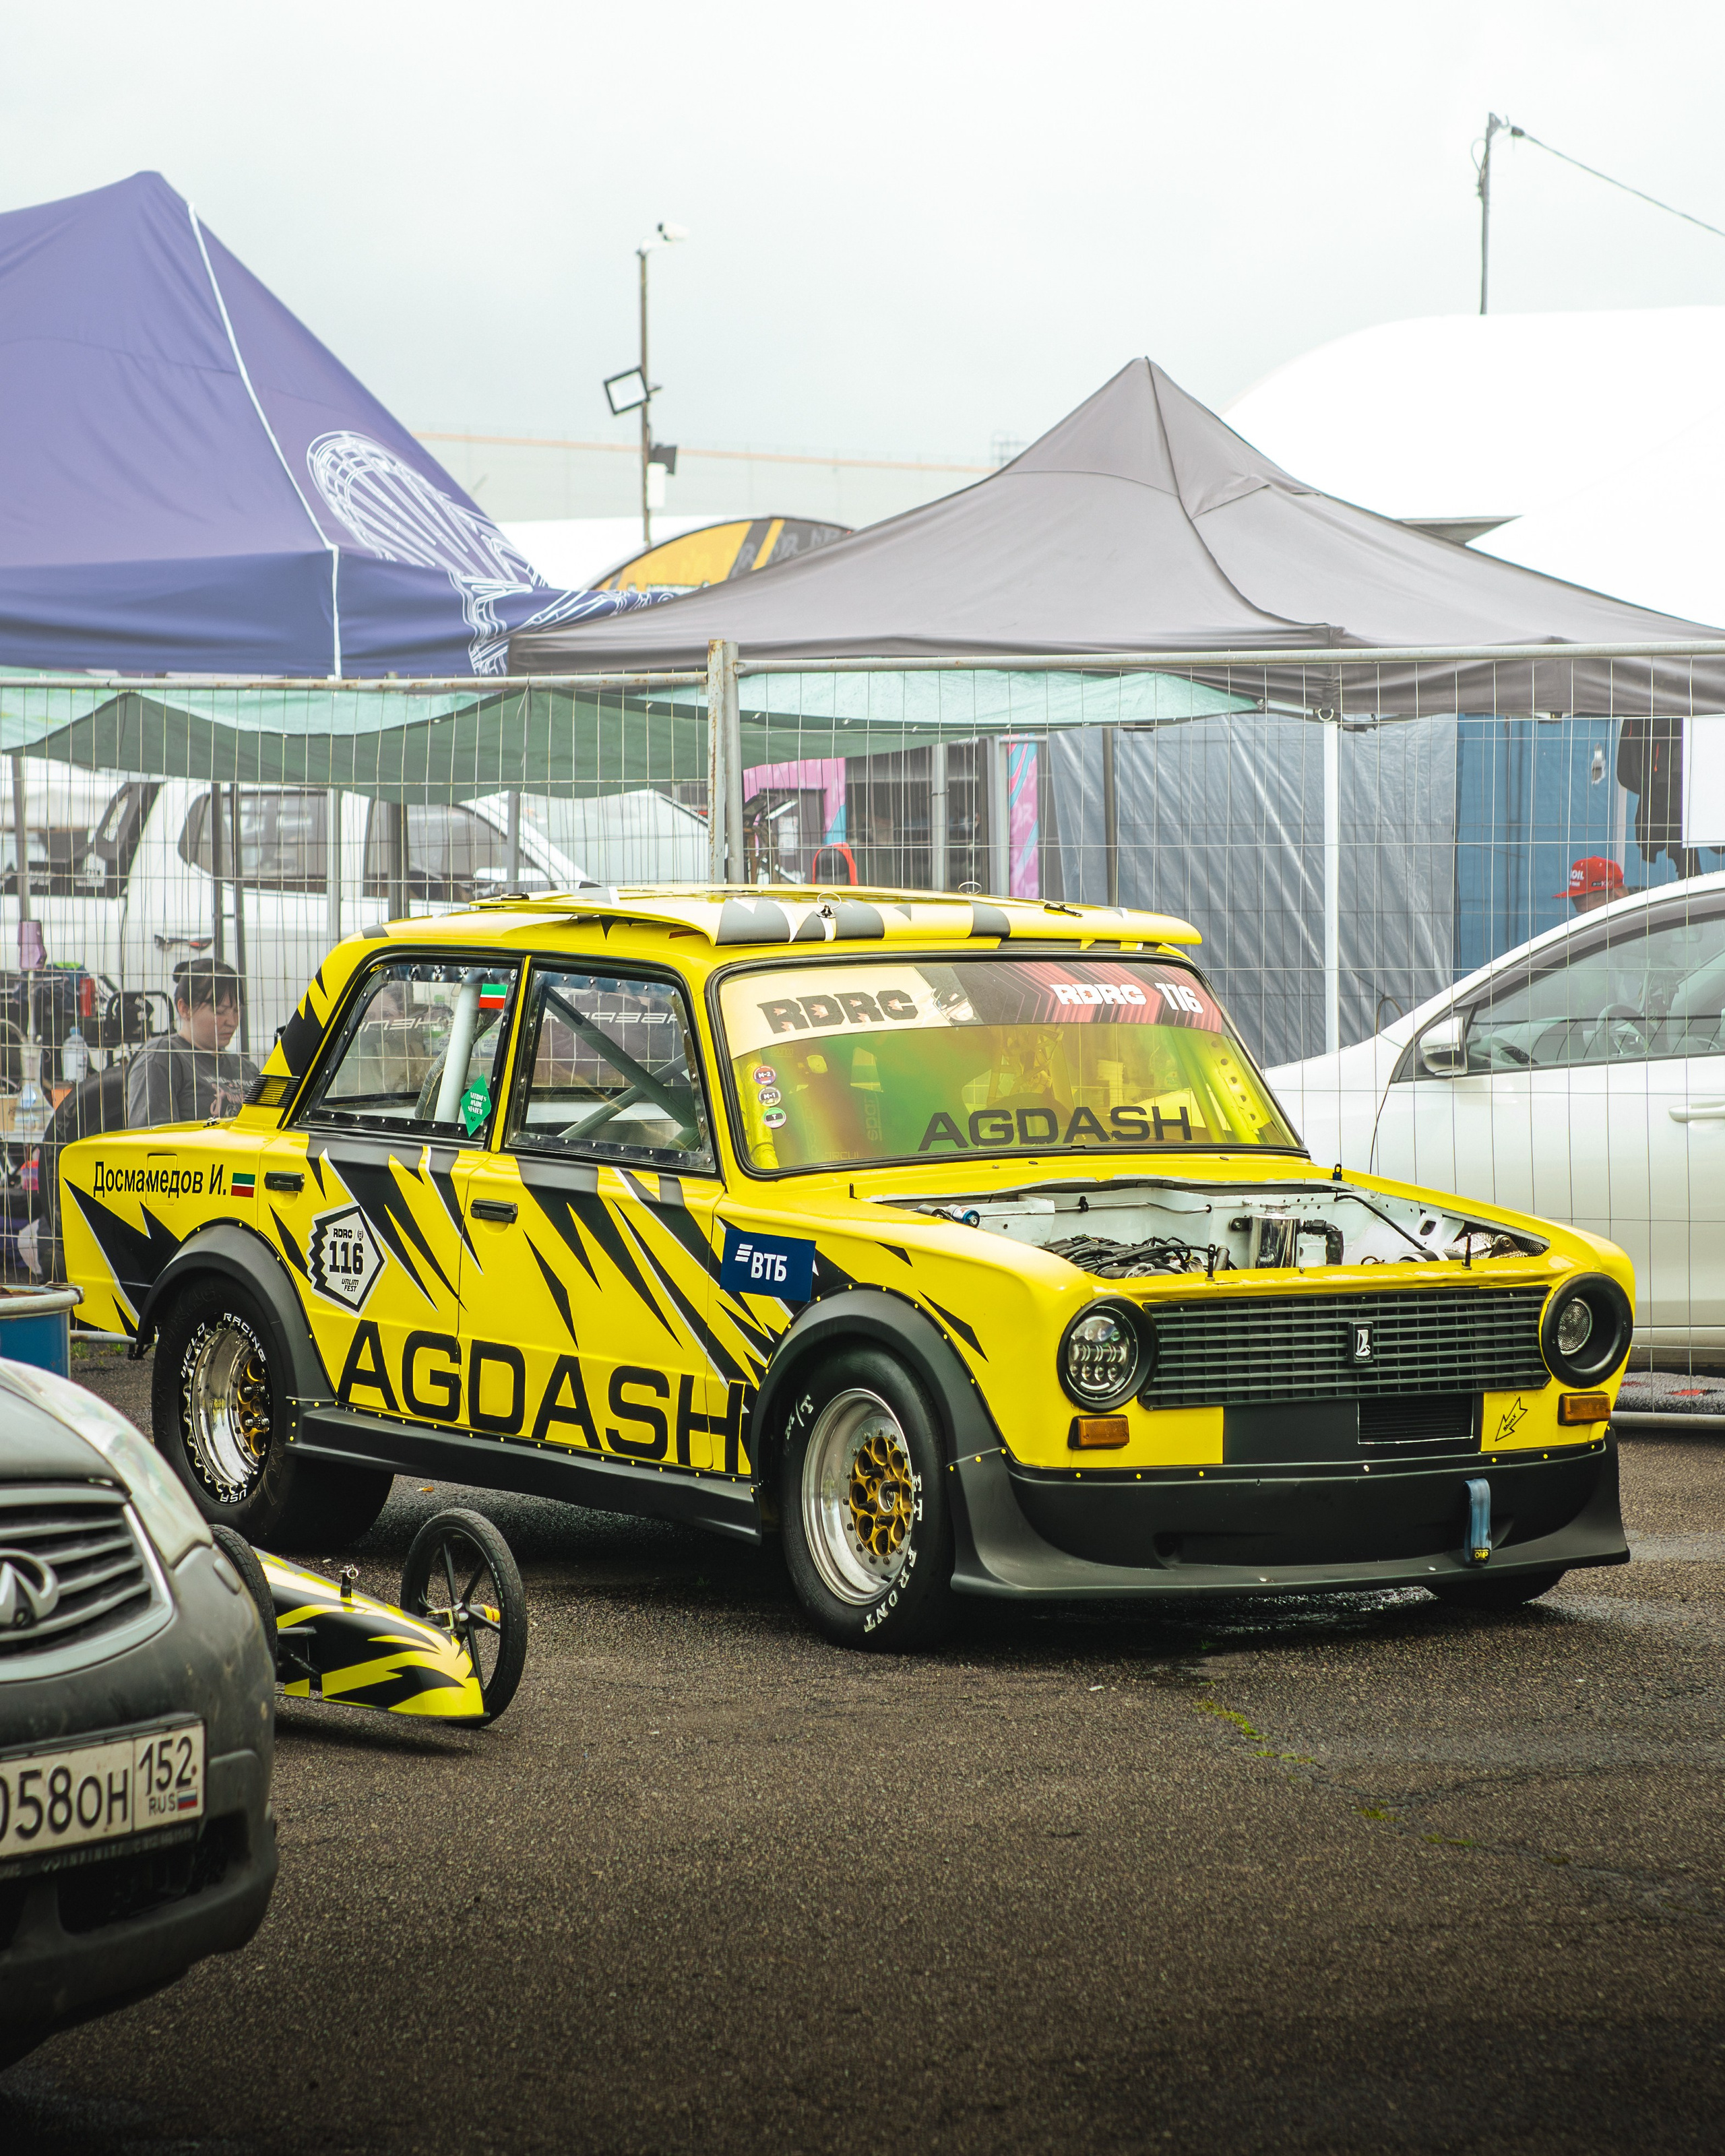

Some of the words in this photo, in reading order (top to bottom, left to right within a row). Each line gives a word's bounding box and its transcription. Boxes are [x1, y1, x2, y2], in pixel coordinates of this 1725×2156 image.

[757, 990, 918, 1034] RDRC
[1049, 983, 1147, 1006] RDRC
[1154, 982, 1204, 1014] 116
[917, 1106, 1193, 1151] AGDASH
[93, 1161, 203, 1197] Досмамедов
[209, 1164, 227, 1195] И.
[333, 1228, 352, 1238] RDRC
[330, 1240, 363, 1275] 116
[751, 1251, 788, 1281] ВТБ
[223, 1312, 266, 1362] RACING
[337, 1319, 744, 1474] AGDASH
[220, 1489, 247, 1503] USA
[864, 1546, 918, 1633] FRONT
[137, 1736, 193, 1797] 152
[148, 1793, 176, 1816] RUS
